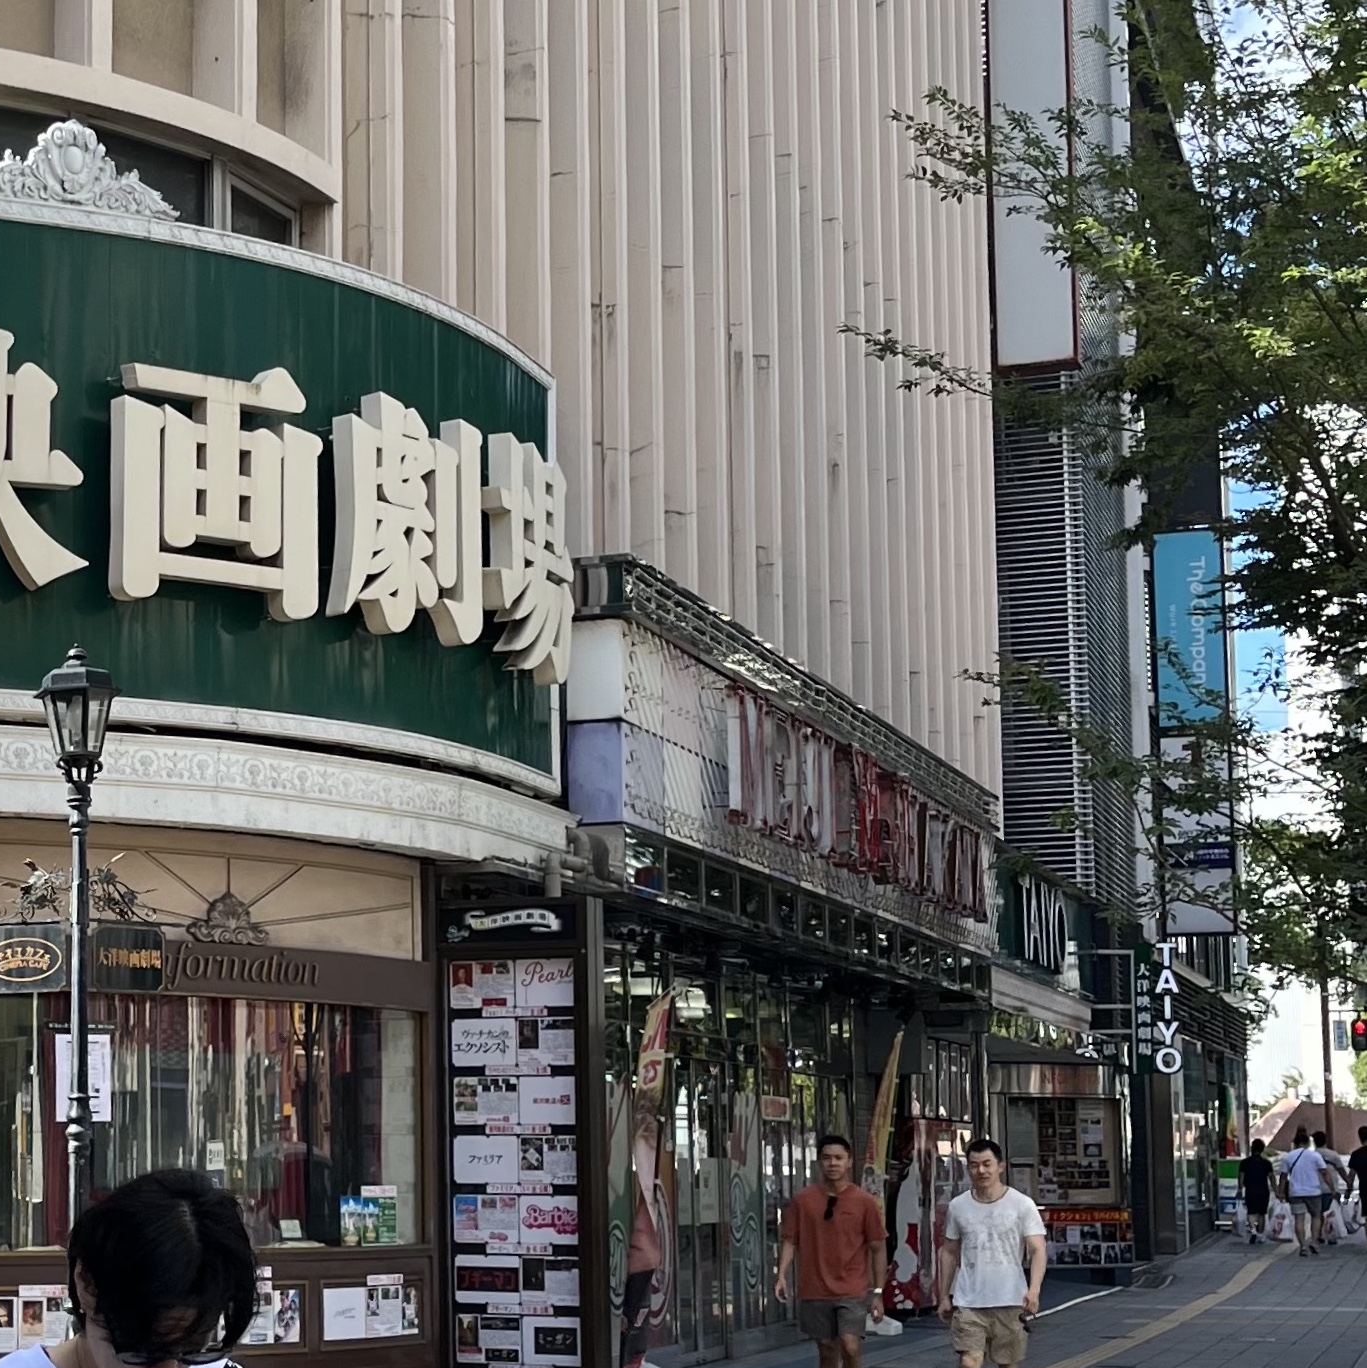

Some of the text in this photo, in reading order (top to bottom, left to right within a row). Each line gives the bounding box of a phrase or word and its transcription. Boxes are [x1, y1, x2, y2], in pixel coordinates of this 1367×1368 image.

[1186, 556, 1208, 694] The Compan
[97, 947, 162, 969] 大洋映画劇場
[166, 942, 319, 989] nformation
[521, 961, 574, 987] Pearl
[1155, 943, 1182, 1074] TAIYO
[453, 1040, 510, 1054] エクソシスト
[522, 1204, 578, 1229] Barbie
